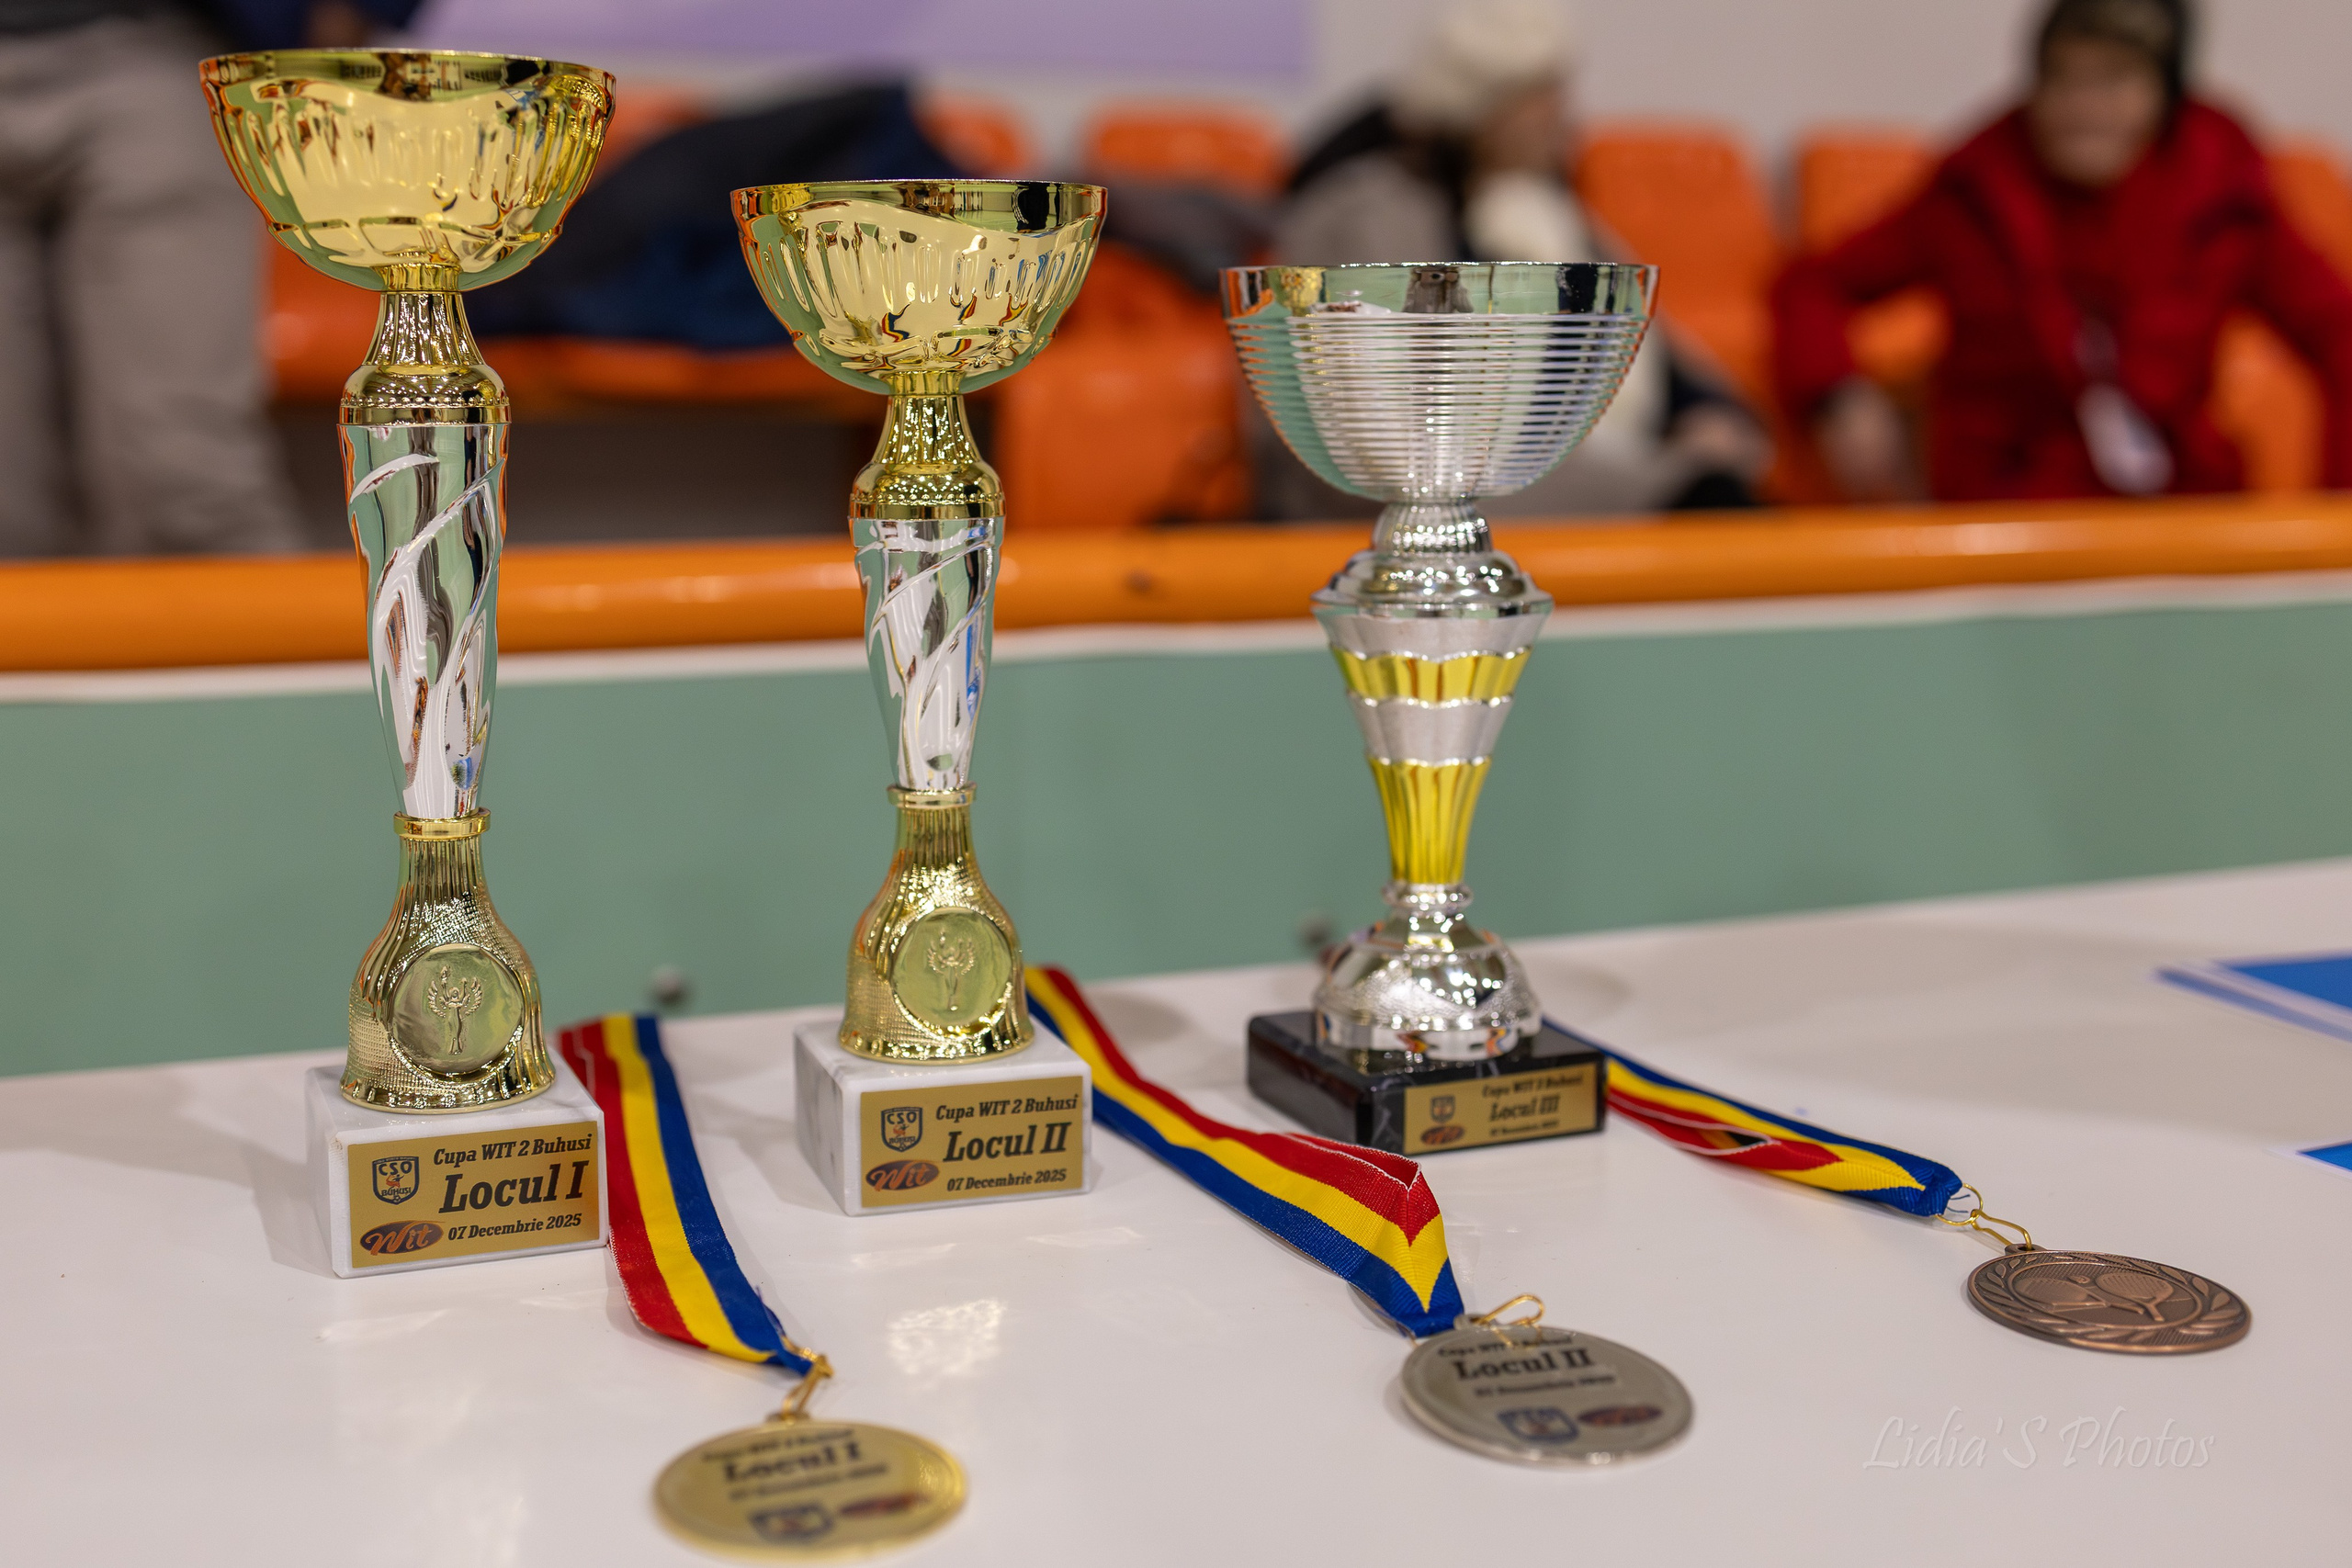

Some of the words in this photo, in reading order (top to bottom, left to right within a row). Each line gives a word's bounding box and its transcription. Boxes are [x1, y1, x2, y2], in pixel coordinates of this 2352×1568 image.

[887, 1111, 917, 1124] CSO
[936, 1105, 974, 1122] Cupa
[978, 1100, 1011, 1117] WIT
[1011, 1100, 1023, 1114] 2
[1024, 1093, 1080, 1113] Buhusi
[434, 1148, 477, 1168] Cupa
[481, 1141, 516, 1160] WIT
[517, 1140, 530, 1156] 2
[532, 1134, 593, 1156] Buhusi
[943, 1124, 1037, 1162] Locul
[1040, 1122, 1072, 1154] II
[379, 1161, 413, 1176] CSO
[870, 1161, 930, 1191] Wit
[946, 1178, 963, 1191] 07
[965, 1171, 1033, 1190] Decembrie
[1034, 1168, 1067, 1183] 2025
[438, 1163, 561, 1213] Locul
[565, 1160, 590, 1200] I
[367, 1221, 433, 1256] Wit
[448, 1226, 467, 1241] 07
[468, 1217, 545, 1239] Decembrie
[546, 1213, 582, 1229] 2025
[1453, 1352, 1558, 1380] Locul
[1561, 1348, 1594, 1369] II
